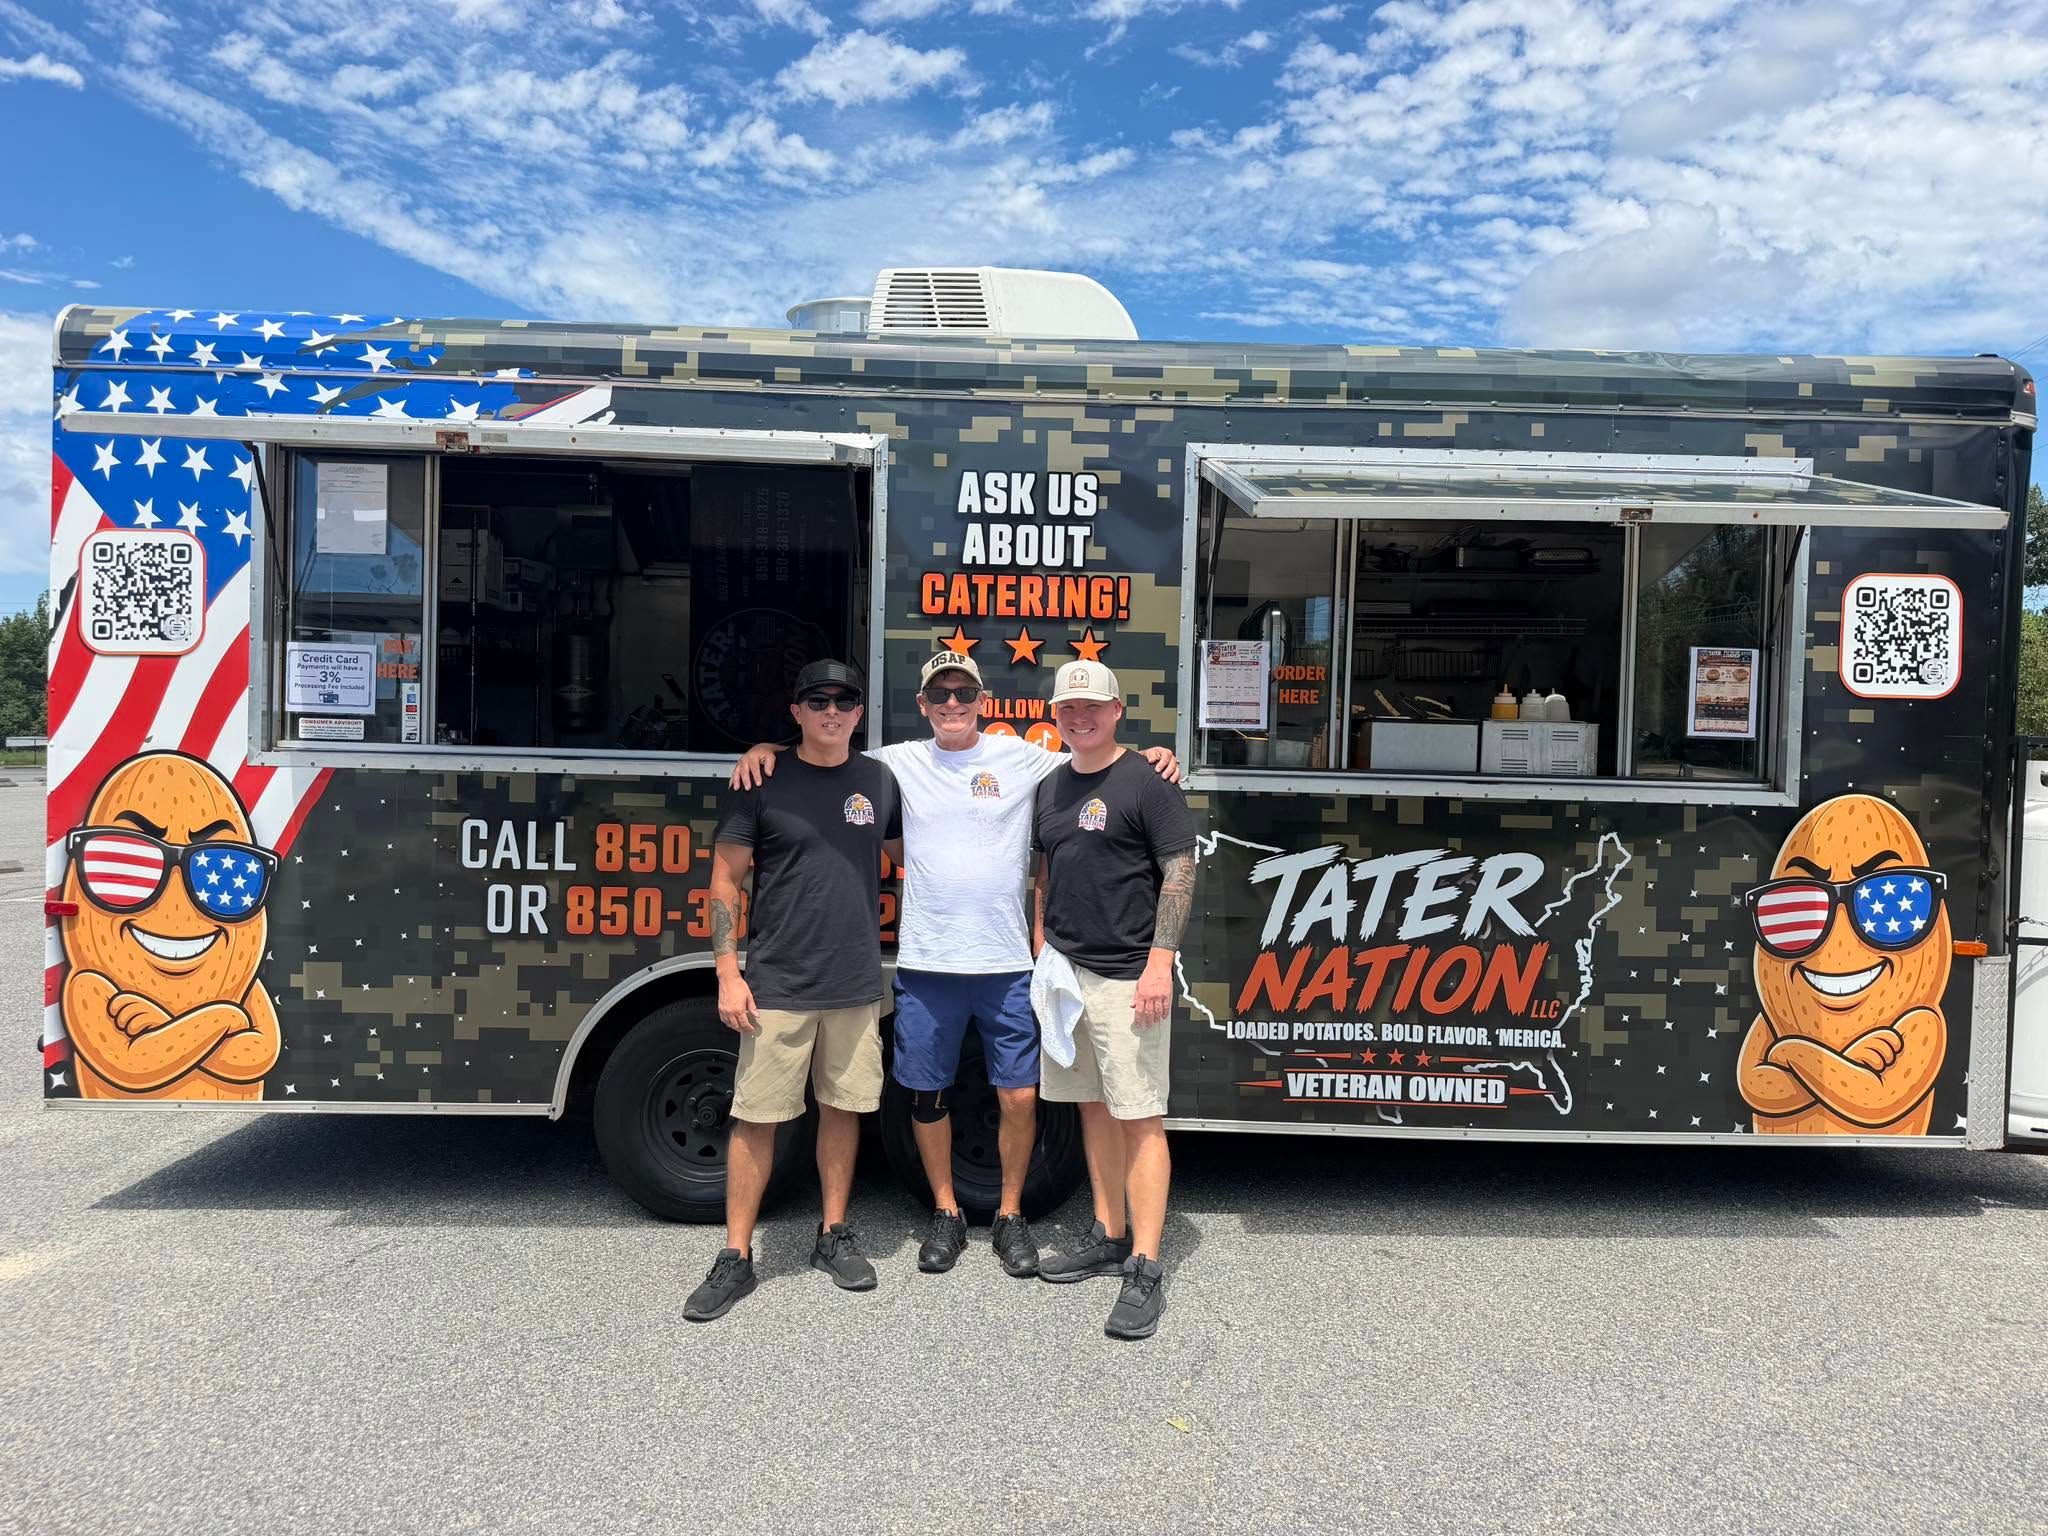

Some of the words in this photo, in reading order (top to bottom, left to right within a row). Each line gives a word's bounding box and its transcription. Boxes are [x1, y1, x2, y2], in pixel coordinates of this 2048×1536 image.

[957, 471, 1036, 515] ASK
[1048, 473, 1099, 517] US
[962, 523, 1091, 568] ABOUT
[921, 573, 1131, 619] CATERING!
[296, 662, 329, 671] Payments
[302, 653, 333, 663] Credit
[336, 655, 359, 664] Card
[931, 652, 965, 670] USAF
[319, 671, 341, 683] 3%
[377, 664, 417, 679] HERE
[1274, 665, 1326, 681] ORDER
[294, 682, 326, 690] Processing
[1278, 688, 1320, 705] HERE
[982, 698, 1046, 719] OLLOW
[845, 809, 874, 817] TATER
[461, 818, 577, 871] CALL
[1248, 844, 1546, 951] TATER
[487, 883, 549, 934] OR
[1236, 940, 1550, 1017] NATION
[1530, 999, 1561, 1019] LLC
[1226, 1020, 1289, 1040] LOADED
[1292, 1022, 1379, 1042] POTATOES.
[1381, 1023, 1424, 1043] BOLD
[1427, 1025, 1492, 1046] FLAVOR.
[1286, 1072, 1402, 1101] VETERAN
[1408, 1075, 1506, 1105] OWNED
